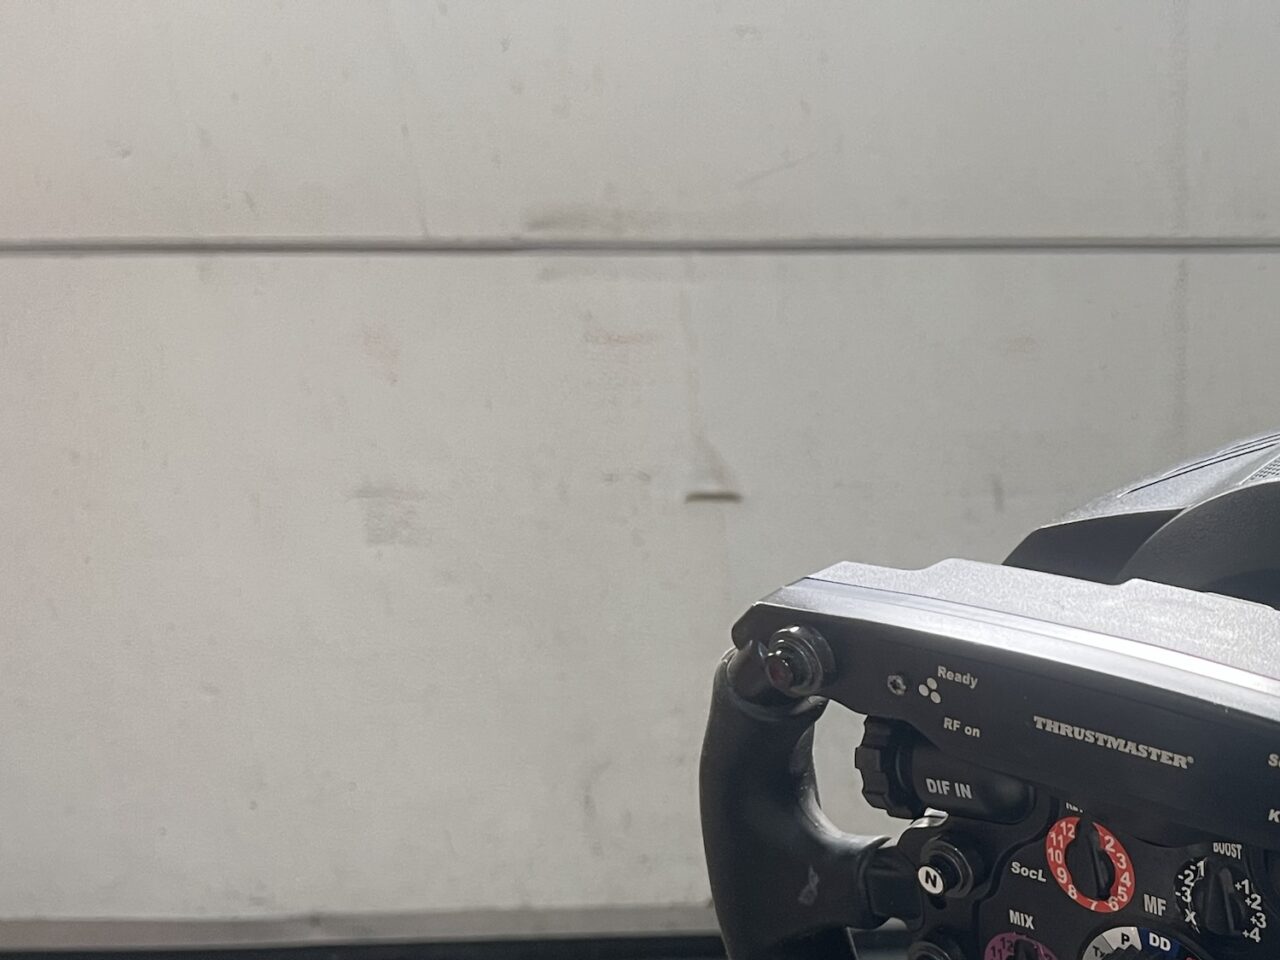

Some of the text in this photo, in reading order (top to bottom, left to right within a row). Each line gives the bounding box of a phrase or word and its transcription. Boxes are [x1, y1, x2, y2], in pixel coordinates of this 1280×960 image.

[937, 665, 978, 689] Ready
[943, 717, 981, 738] RF on
[926, 778, 973, 800] DIF IN
[1268, 808, 1280, 823] K
[1060, 821, 1076, 839] 12
[1049, 831, 1064, 849] 11
[1104, 835, 1116, 853] 2
[1048, 847, 1063, 864] 10
[1116, 853, 1127, 869] 3
[925, 870, 937, 889] N
[1010, 861, 1047, 882] SocL
[1056, 867, 1067, 884] 9
[1120, 871, 1132, 888] 4
[1067, 884, 1078, 900] 8
[1117, 886, 1128, 902] 5
[1087, 898, 1098, 911] 7
[1108, 896, 1119, 912] 6
[1143, 893, 1167, 917] MF
[1235, 879, 1267, 943] +1 +2 +3 +4
[1009, 909, 1035, 930] MIX
[1121, 933, 1130, 946] P
[1149, 932, 1171, 951] DD
